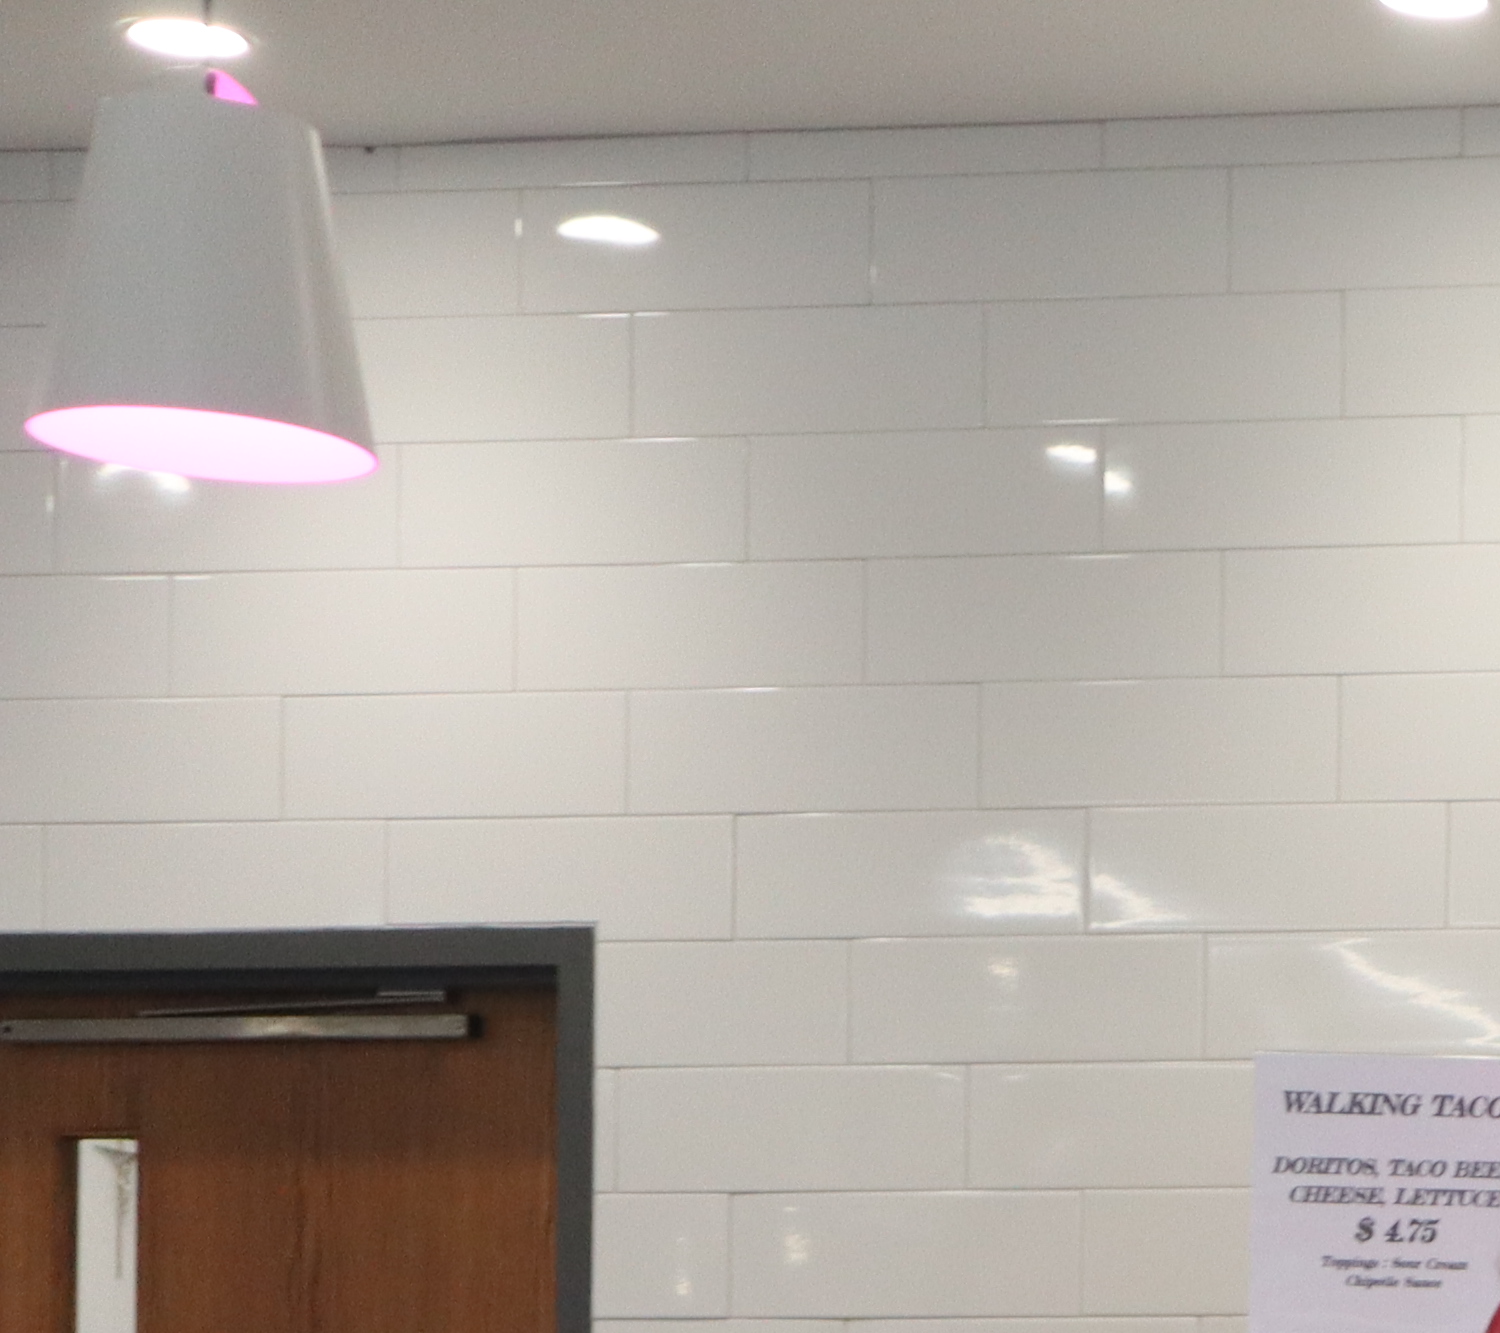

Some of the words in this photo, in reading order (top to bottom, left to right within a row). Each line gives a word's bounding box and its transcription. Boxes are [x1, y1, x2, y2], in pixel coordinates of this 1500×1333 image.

[1283, 1090, 1424, 1117] WALKING
[1271, 1155, 1380, 1179] DORITOS,
[1387, 1159, 1447, 1179] TACO
